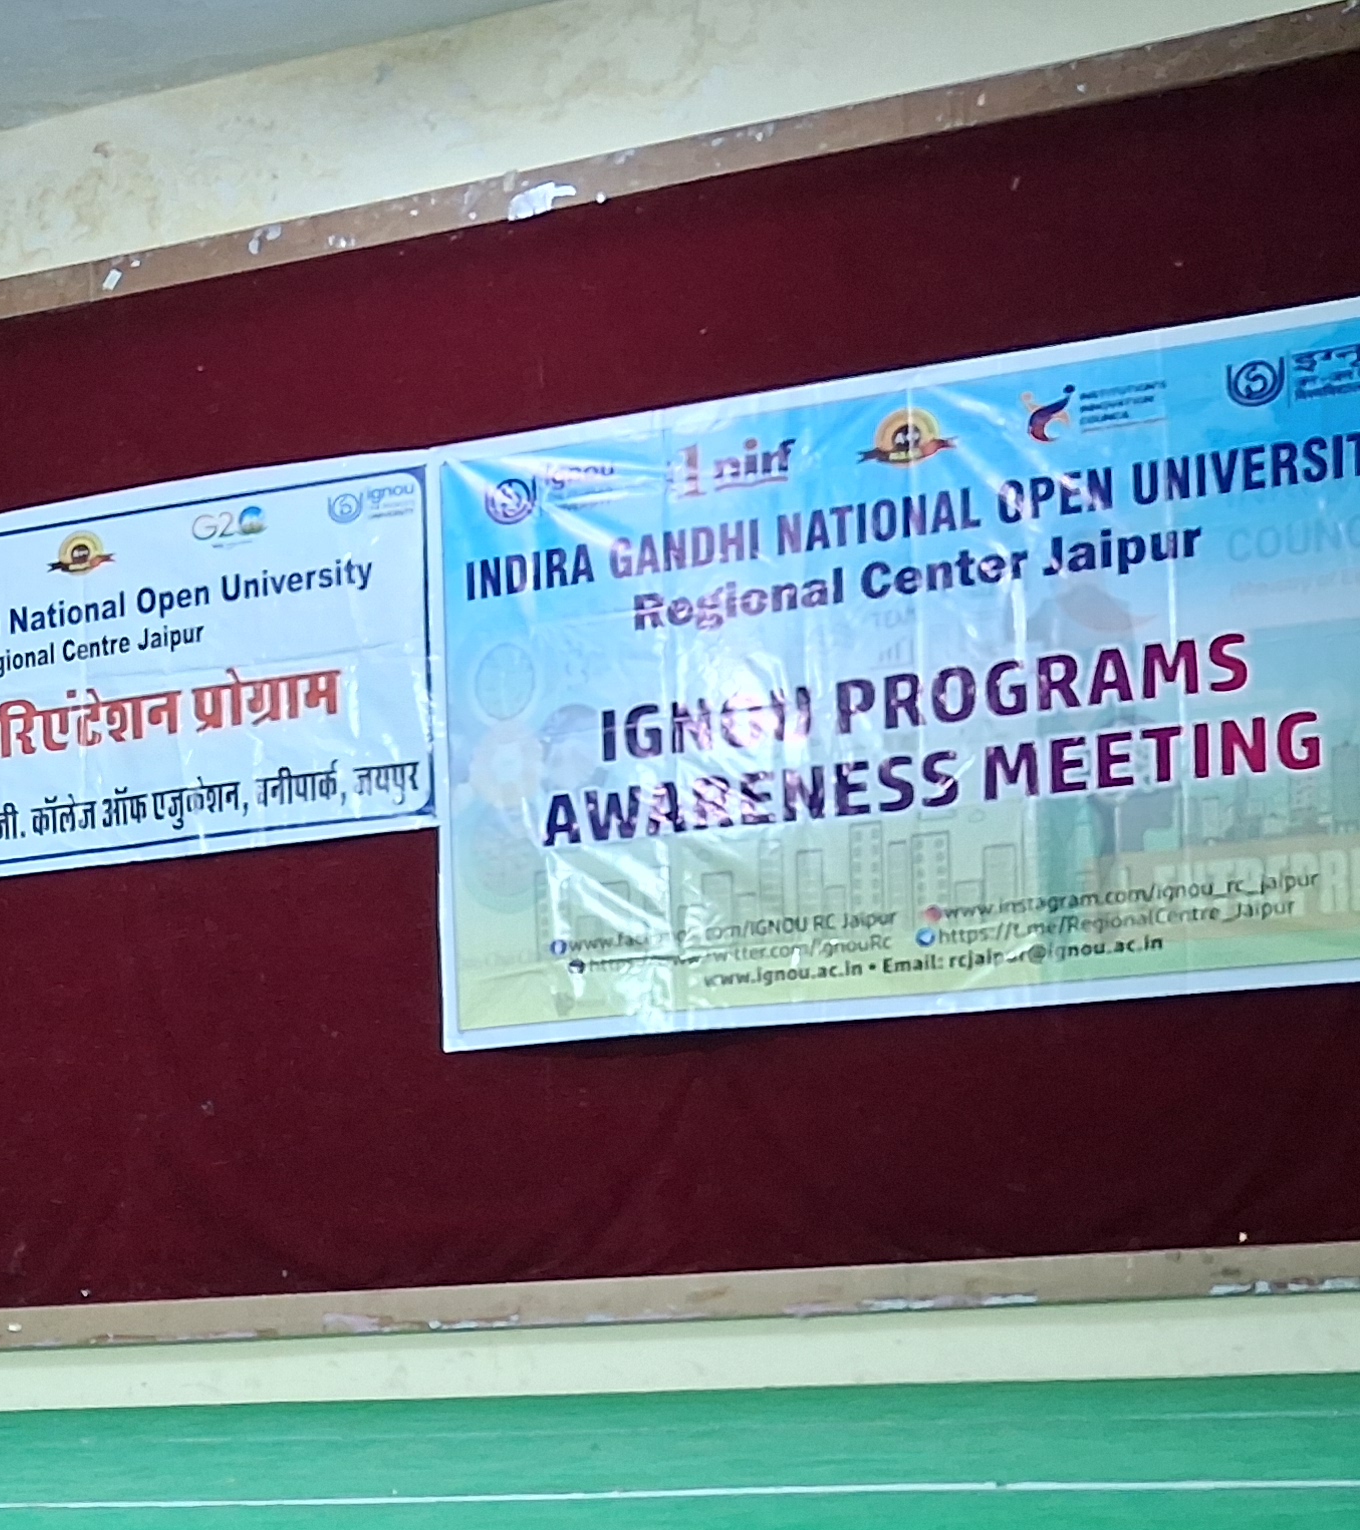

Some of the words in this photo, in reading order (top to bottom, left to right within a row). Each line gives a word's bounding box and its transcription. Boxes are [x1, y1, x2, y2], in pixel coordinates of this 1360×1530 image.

[465, 546, 595, 602] INDIRA
[609, 518, 760, 579] GANDHI
[776, 485, 982, 554] NATIONAL
[996, 467, 1114, 527] OPEN
[1130, 432, 1360, 507] UNIVERSIT
[9, 591, 126, 635] National
[136, 582, 211, 620] Open
[220, 557, 374, 604] University
[633, 566, 845, 631] Regional
[860, 544, 1028, 600] Center
[1042, 522, 1203, 578] Jaipur
[62, 634, 132, 663] Centre
[137, 621, 205, 656] Jaipur
[192, 667, 342, 734] प्रोग्राम
[835, 634, 1250, 737] PROGRAMS
[30, 793, 97, 836] कॉलेज
[102, 786, 147, 828] ऑफ
[352, 761, 420, 806] जयपुर
[541, 749, 960, 847] AWARENESS
[982, 711, 1323, 801] MEETING
[841, 910, 897, 934] Jaipur
[882, 954, 945, 974] Email:
